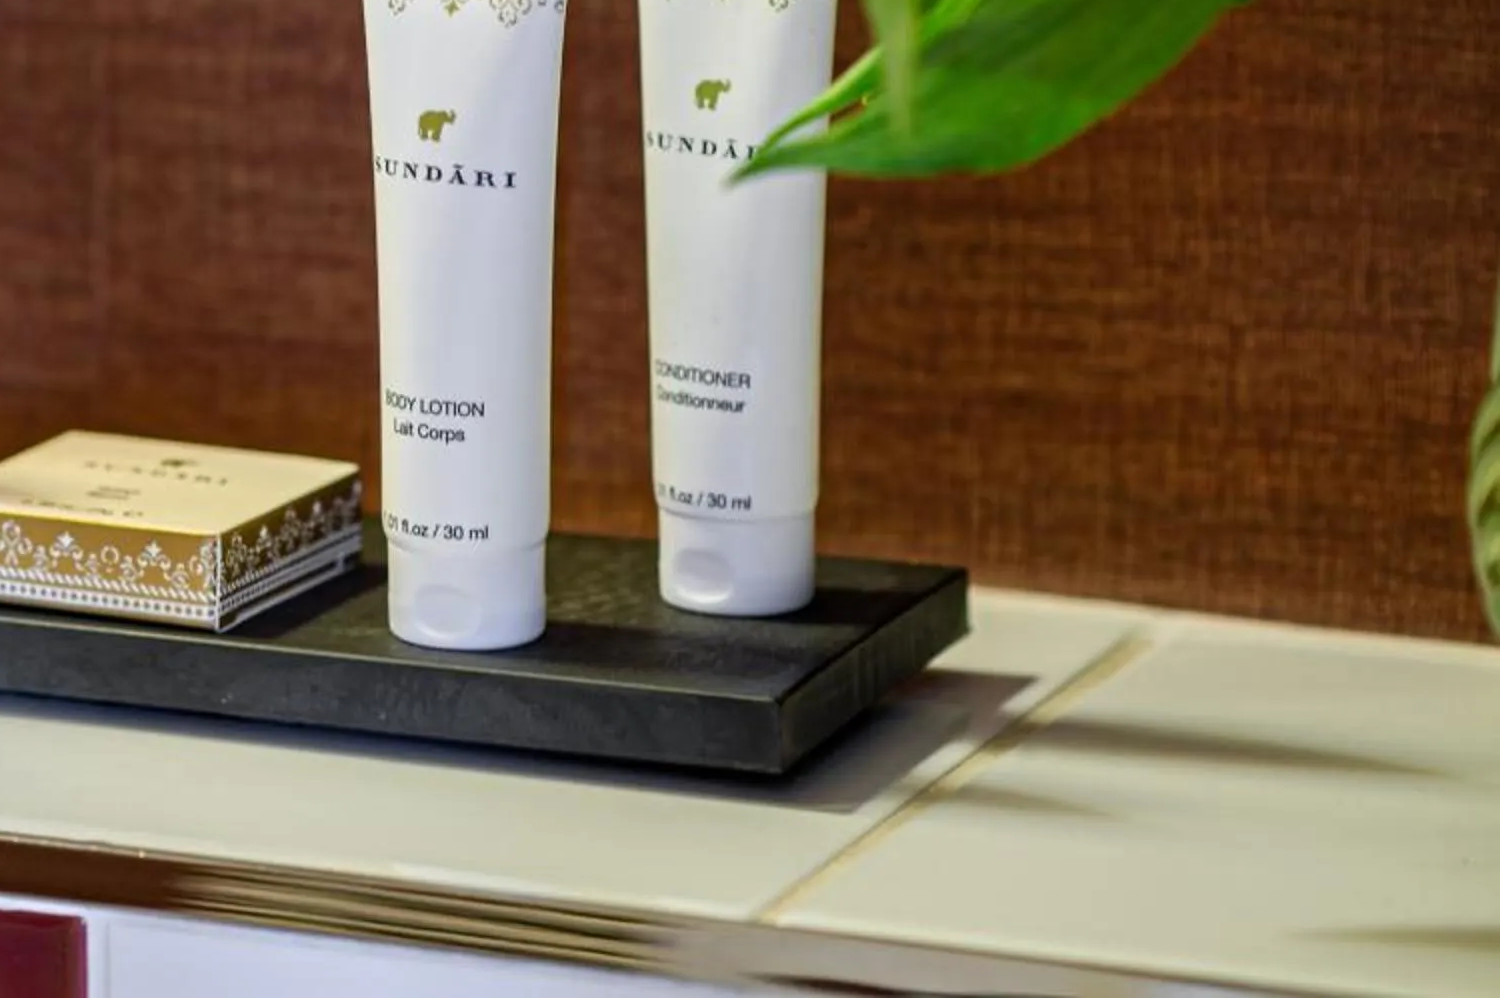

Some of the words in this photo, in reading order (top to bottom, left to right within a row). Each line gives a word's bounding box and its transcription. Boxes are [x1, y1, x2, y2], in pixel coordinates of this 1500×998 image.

[419, 399, 485, 418] LOTION
[393, 417, 414, 437] Lait
[417, 423, 466, 445] Corps
[707, 491, 728, 510] 30
[732, 494, 753, 511] ml
[443, 524, 464, 541] 30
[469, 524, 489, 541] ml
